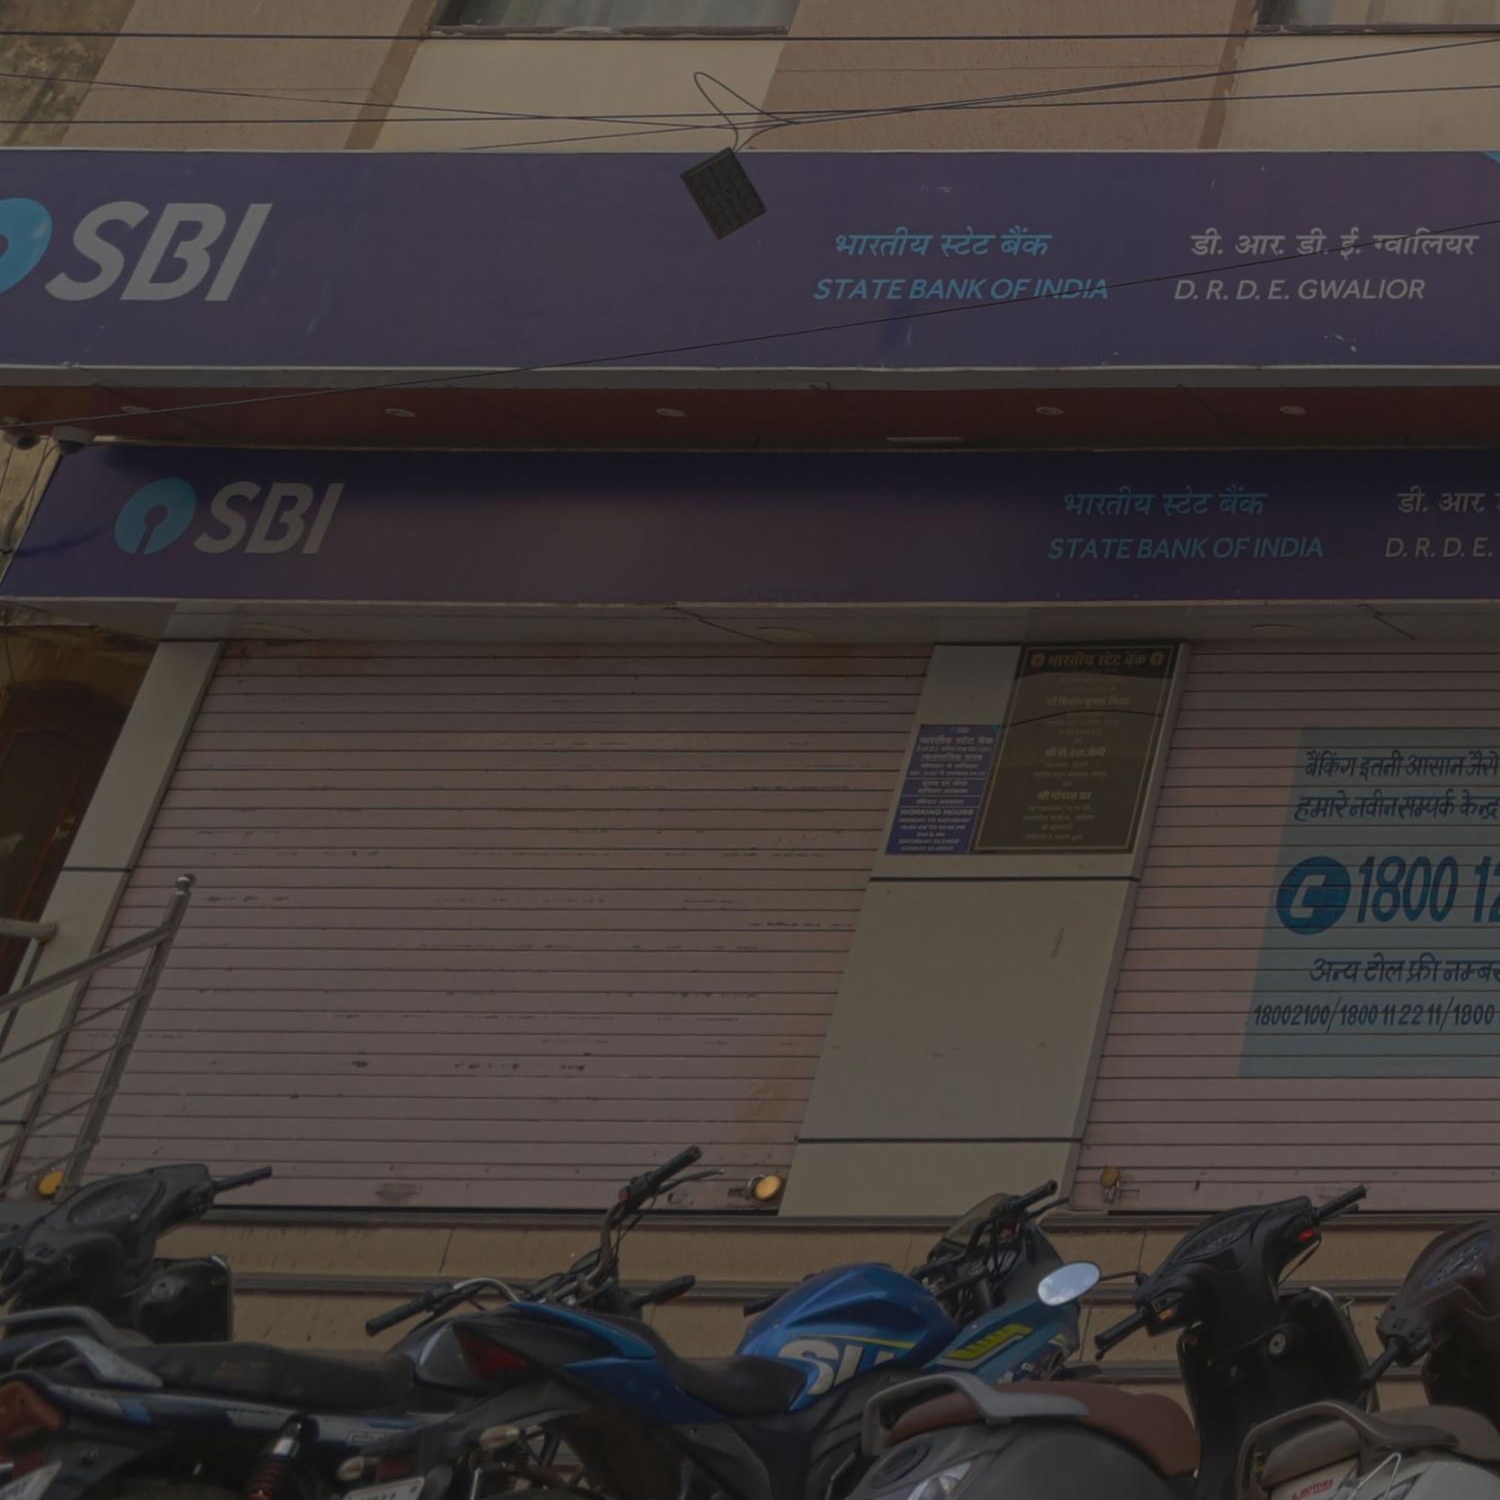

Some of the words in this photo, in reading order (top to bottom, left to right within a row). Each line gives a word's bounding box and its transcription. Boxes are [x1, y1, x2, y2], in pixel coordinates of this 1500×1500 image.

[45, 200, 275, 302] SBI
[835, 226, 934, 257] भारतीय
[940, 226, 996, 257] स्टेट
[1000, 223, 1053, 257] बैंक
[1190, 227, 1224, 257] डी.
[1234, 233, 1286, 257] आर.
[1296, 227, 1328, 257] डी.
[1340, 226, 1361, 261] ई.
[1372, 227, 1480, 257] ग्वालियर
[812, 277, 907, 301] STATE
[908, 277, 987, 301] BANK
[990, 277, 1031, 301] OF
[1033, 277, 1110, 301] INDIA
[1173, 278, 1199, 301] D.
[1206, 278, 1229, 301] R.
[1236, 278, 1260, 301] D.
[1268, 278, 1290, 301] E.
[1298, 278, 1427, 301] GWALIOR
[1063, 485, 1156, 517] भारतीय
[1162, 485, 1215, 517] स्टेट
[1218, 483, 1269, 517] बैंक
[1396, 484, 1428, 514] डी.
[1438, 491, 1486, 514] आर.
[192, 480, 346, 555] SBI
[1047, 537, 1135, 561] STATE
[1136, 537, 1209, 560] BANK
[1212, 537, 1250, 560] OF
[1252, 536, 1325, 558] INDIA
[1384, 536, 1408, 558] D.
[1415, 536, 1436, 558] R.
[1442, 536, 1465, 558] D.
[1472, 536, 1493, 558] E.
[1304, 750, 1358, 778] बैंकिंग
[1359, 750, 1404, 781] इतनी
[1405, 755, 1466, 778] आसान
[1465, 750, 1499, 777] जैसे
[1294, 789, 1349, 821] हमारे
[1349, 789, 1399, 819] नवीन
[1398, 788, 1456, 819] सम्पर्क
[1458, 789, 1500, 821] केन्द्र
[1356, 854, 1459, 924] 1800
[1309, 957, 1362, 982] अन्य
[1363, 951, 1405, 982] टोल
[1405, 951, 1442, 983] फ्री
